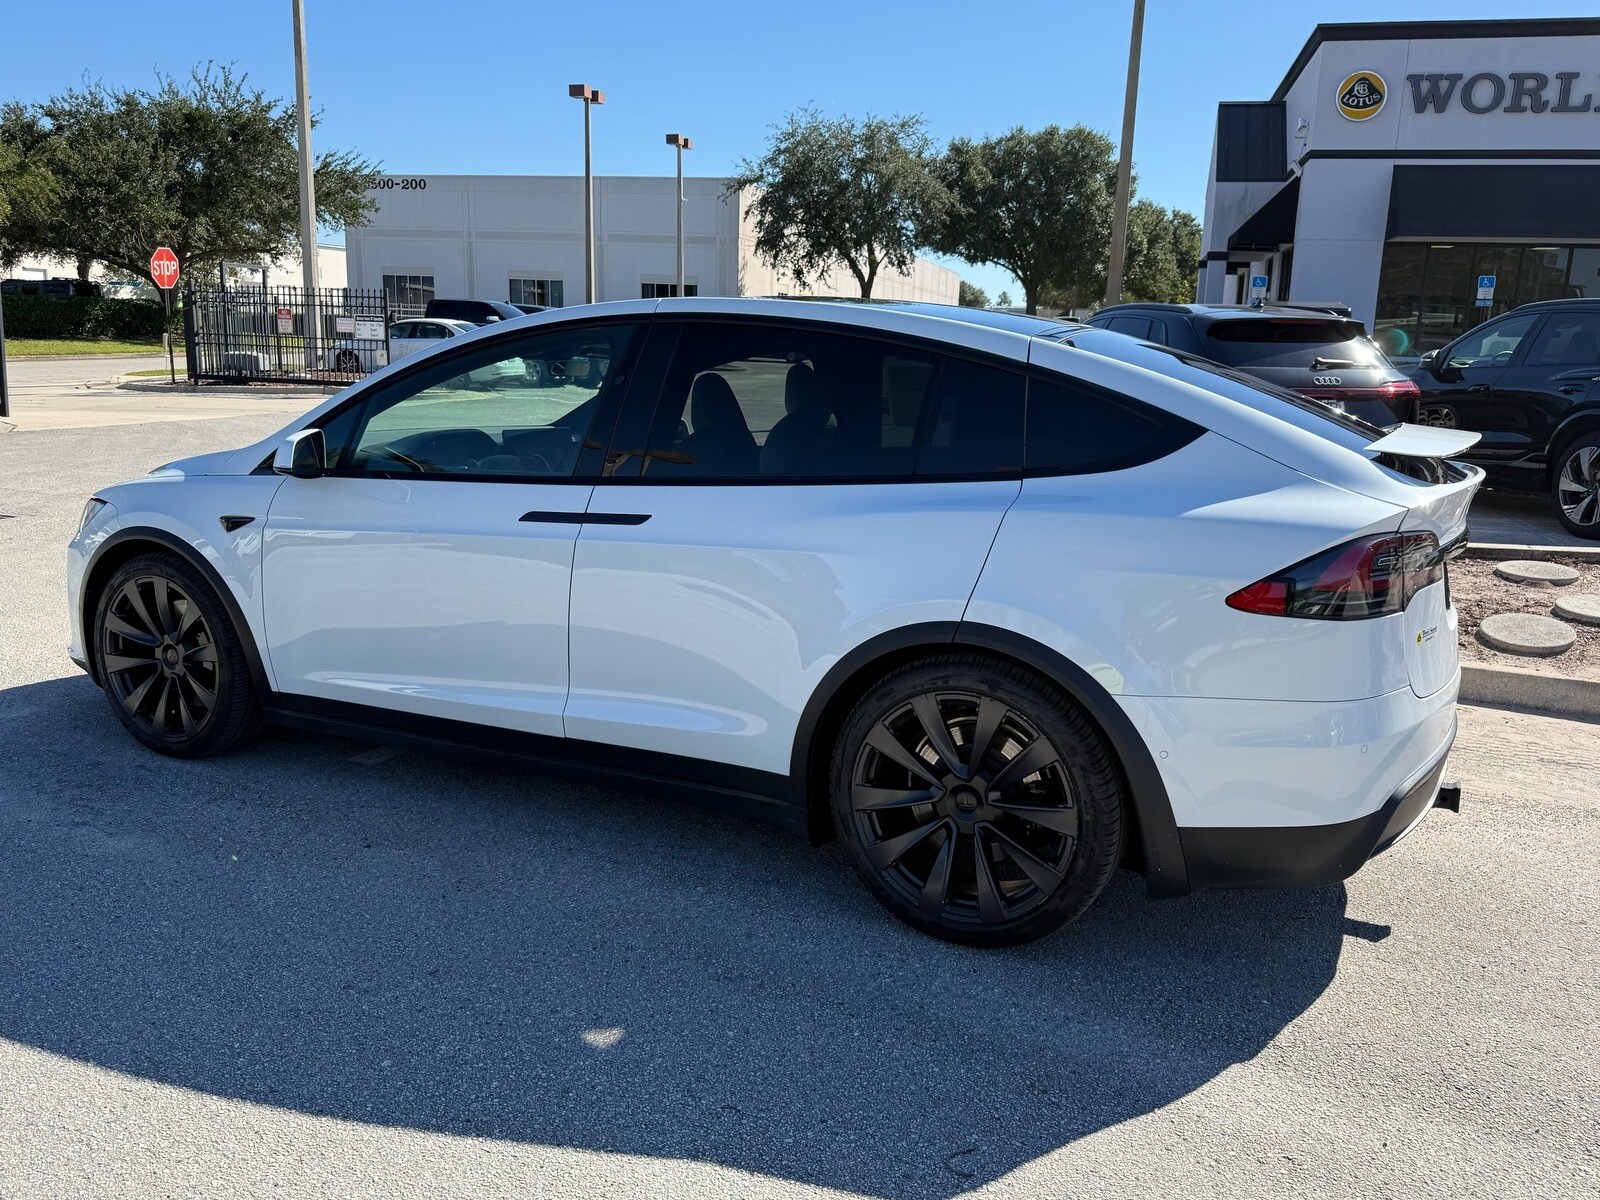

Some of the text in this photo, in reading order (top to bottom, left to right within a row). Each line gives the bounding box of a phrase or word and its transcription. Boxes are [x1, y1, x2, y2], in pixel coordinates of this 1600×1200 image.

[1343, 93, 1380, 106] LOTUS
[1406, 72, 1600, 115] WORL
[153, 260, 177, 276] STOP
